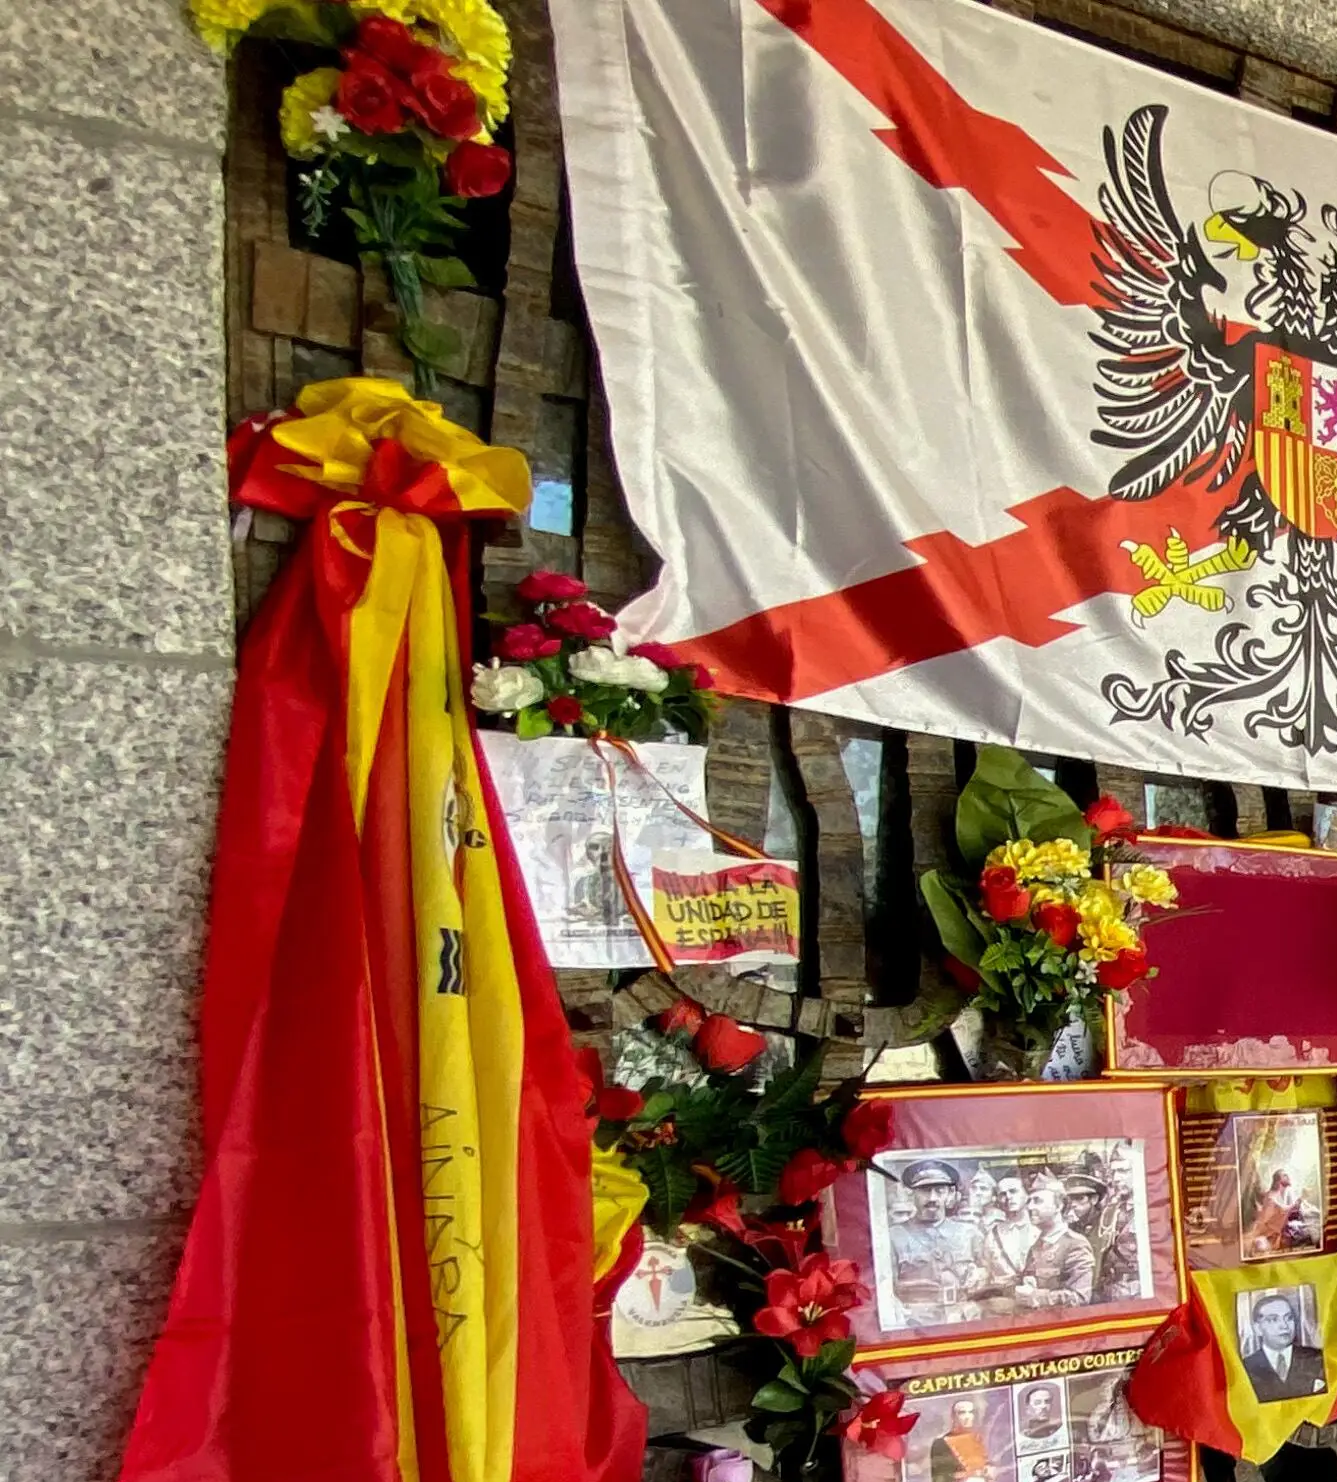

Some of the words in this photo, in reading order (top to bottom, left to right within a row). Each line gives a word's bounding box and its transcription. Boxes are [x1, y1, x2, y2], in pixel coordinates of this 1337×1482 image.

[747, 876, 779, 895] LA
[756, 899, 789, 921] DE
[908, 1370, 991, 1395] CAPITAN
[994, 1357, 1081, 1384] SANTIAGO
